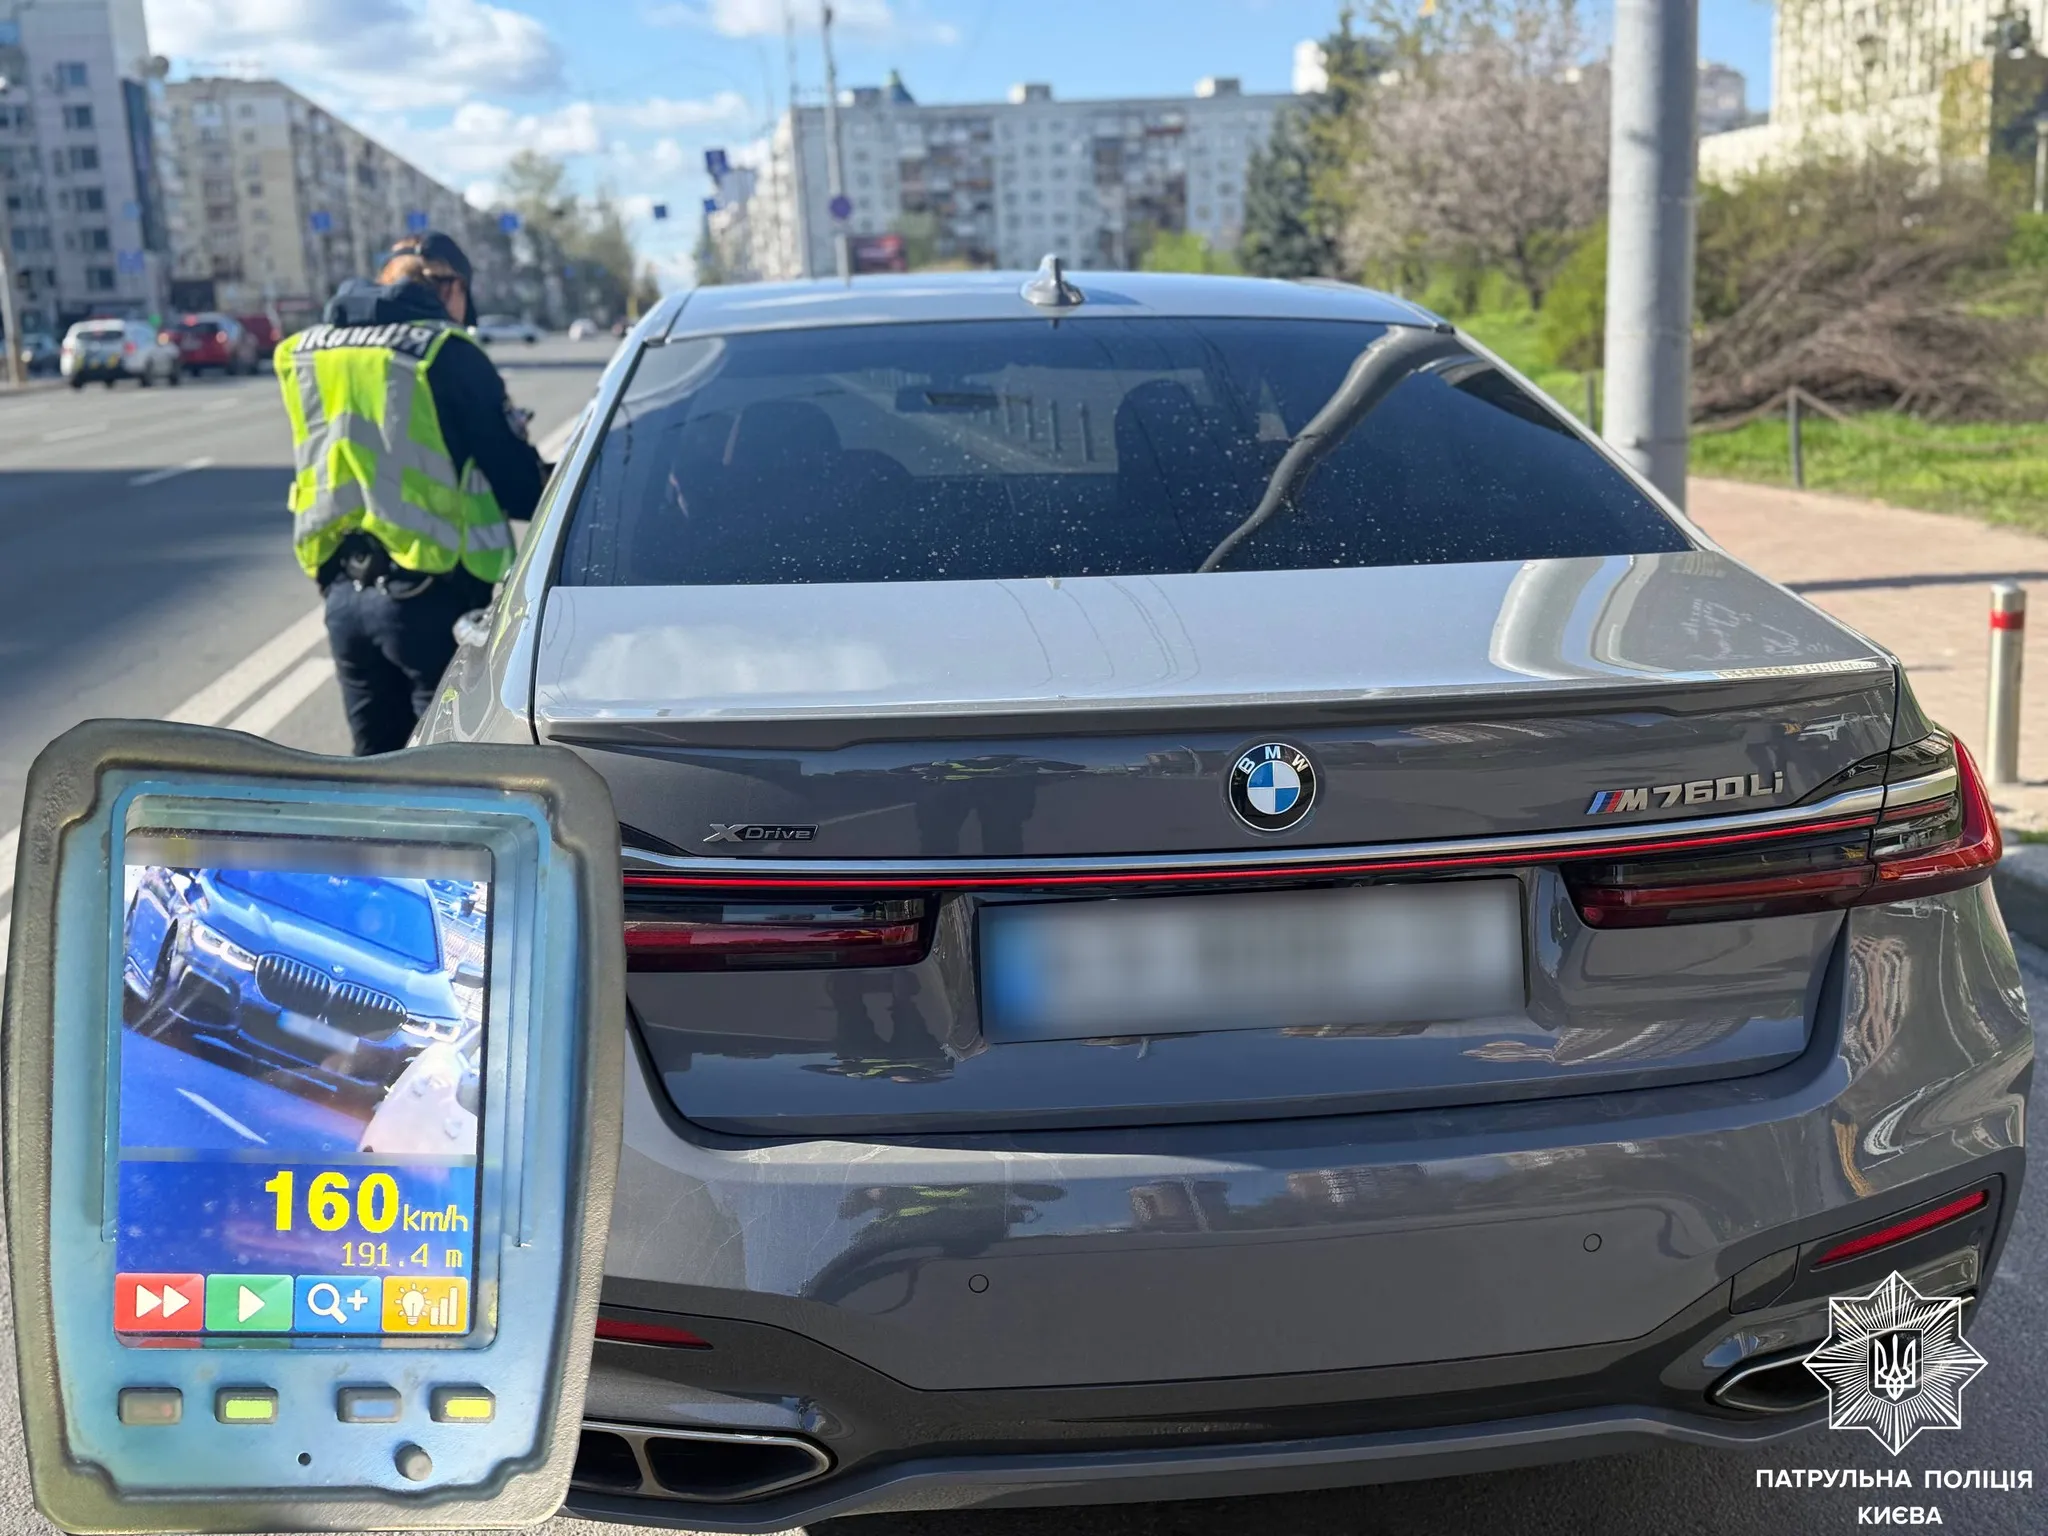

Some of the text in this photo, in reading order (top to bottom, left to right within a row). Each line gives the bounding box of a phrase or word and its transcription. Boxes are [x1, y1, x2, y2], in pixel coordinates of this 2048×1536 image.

[1238, 745, 1309, 775] BMW
[1587, 770, 1784, 814] M760Li
[265, 1170, 469, 1234] 160 km/h
[342, 1241, 463, 1268] 191.4 m
